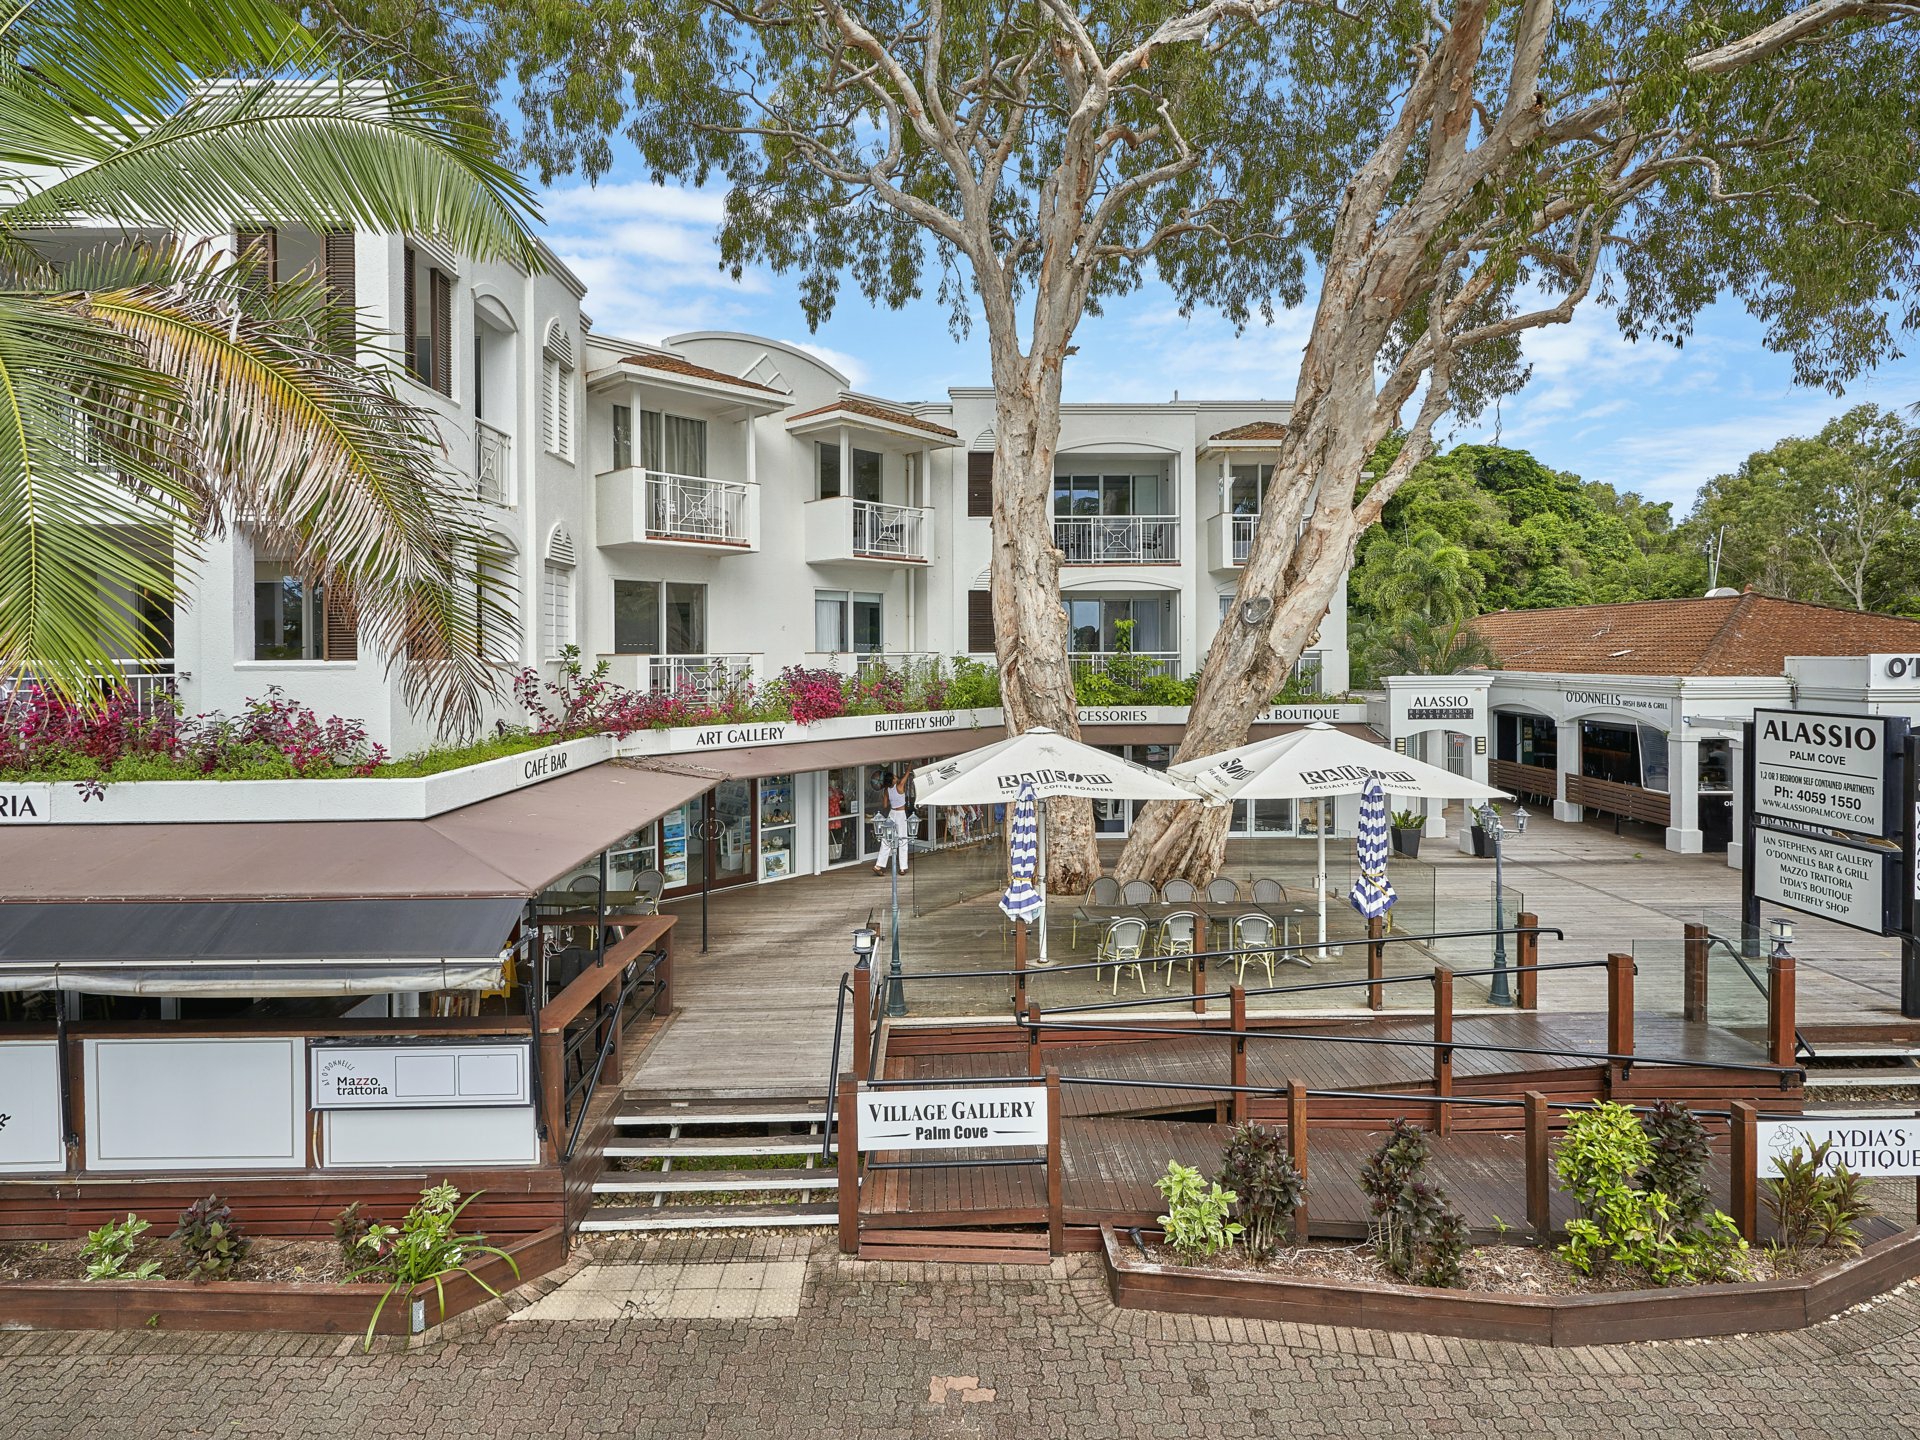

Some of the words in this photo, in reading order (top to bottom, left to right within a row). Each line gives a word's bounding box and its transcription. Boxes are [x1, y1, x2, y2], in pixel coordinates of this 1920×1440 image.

[1413, 695, 1469, 707] ALASSIO
[1566, 691, 1621, 706] O'DONNELLS
[1653, 702, 1668, 710] GRILL
[875, 717, 927, 732] BUTTERFLY
[929, 715, 955, 728] SHOP
[1078, 710, 1147, 721] CESSORIES
[1274, 709, 1340, 720] BOUTIQUE
[696, 731, 723, 745] ART
[727, 726, 785, 744] GALLERY
[1763, 719, 1876, 751] ALASSIO
[524, 753, 548, 779] CAFÉ
[551, 752, 567, 772] BAR
[1789, 750, 1815, 762] PALM
[1818, 753, 1846, 766] COVE
[1309, 782, 1349, 790] SPECIALTY
[1768, 771, 1775, 780] OR
[1775, 772, 1779, 780] 3
[1780, 773, 1802, 785] BEDROOM
[1803, 776, 1814, 786] SELF
[1815, 778, 1842, 790] CONTAINED
[1843, 782, 1875, 796] APARTMENTS
[1774, 785, 1793, 799] Ph:
[1797, 790, 1826, 805] 4059
[1831, 795, 1861, 810] 1550
[1762, 798, 1875, 825] WWW.ALASSIOPALMCOVE.COM
[1763, 836, 1776, 845] IAN
[1778, 839, 1817, 855] STEPHENS
[1818, 849, 1834, 859] ART
[1836, 852, 1873, 868] GALLERY
[1766, 848, 1816, 867] O'DONNELLS
[1818, 860, 1834, 872] BAR
[1836, 865, 1842, 875] &
[1845, 867, 1869, 881] GRILL
[1780, 863, 1808, 878] MAZZO
[1810, 870, 1853, 890] TRATTORIA
[1780, 875, 1808, 890] LYDIA'S
[1809, 883, 1853, 903] BOUTIQUE
[1783, 888, 1823, 907] BUTTERFLY
[1825, 900, 1850, 914] SHOP
[321, 1059, 355, 1077] O'DONNELLS
[337, 1086, 388, 1096] trattoria
[868, 1103, 947, 1122] VILLAGE
[951, 1101, 1036, 1120] GALLERY
[915, 1126, 950, 1141] Palm
[954, 1125, 988, 1140] Cove
[1828, 1128, 1906, 1147] LYDIA'S
[1817, 1149, 1920, 1169] OUTIQUE
